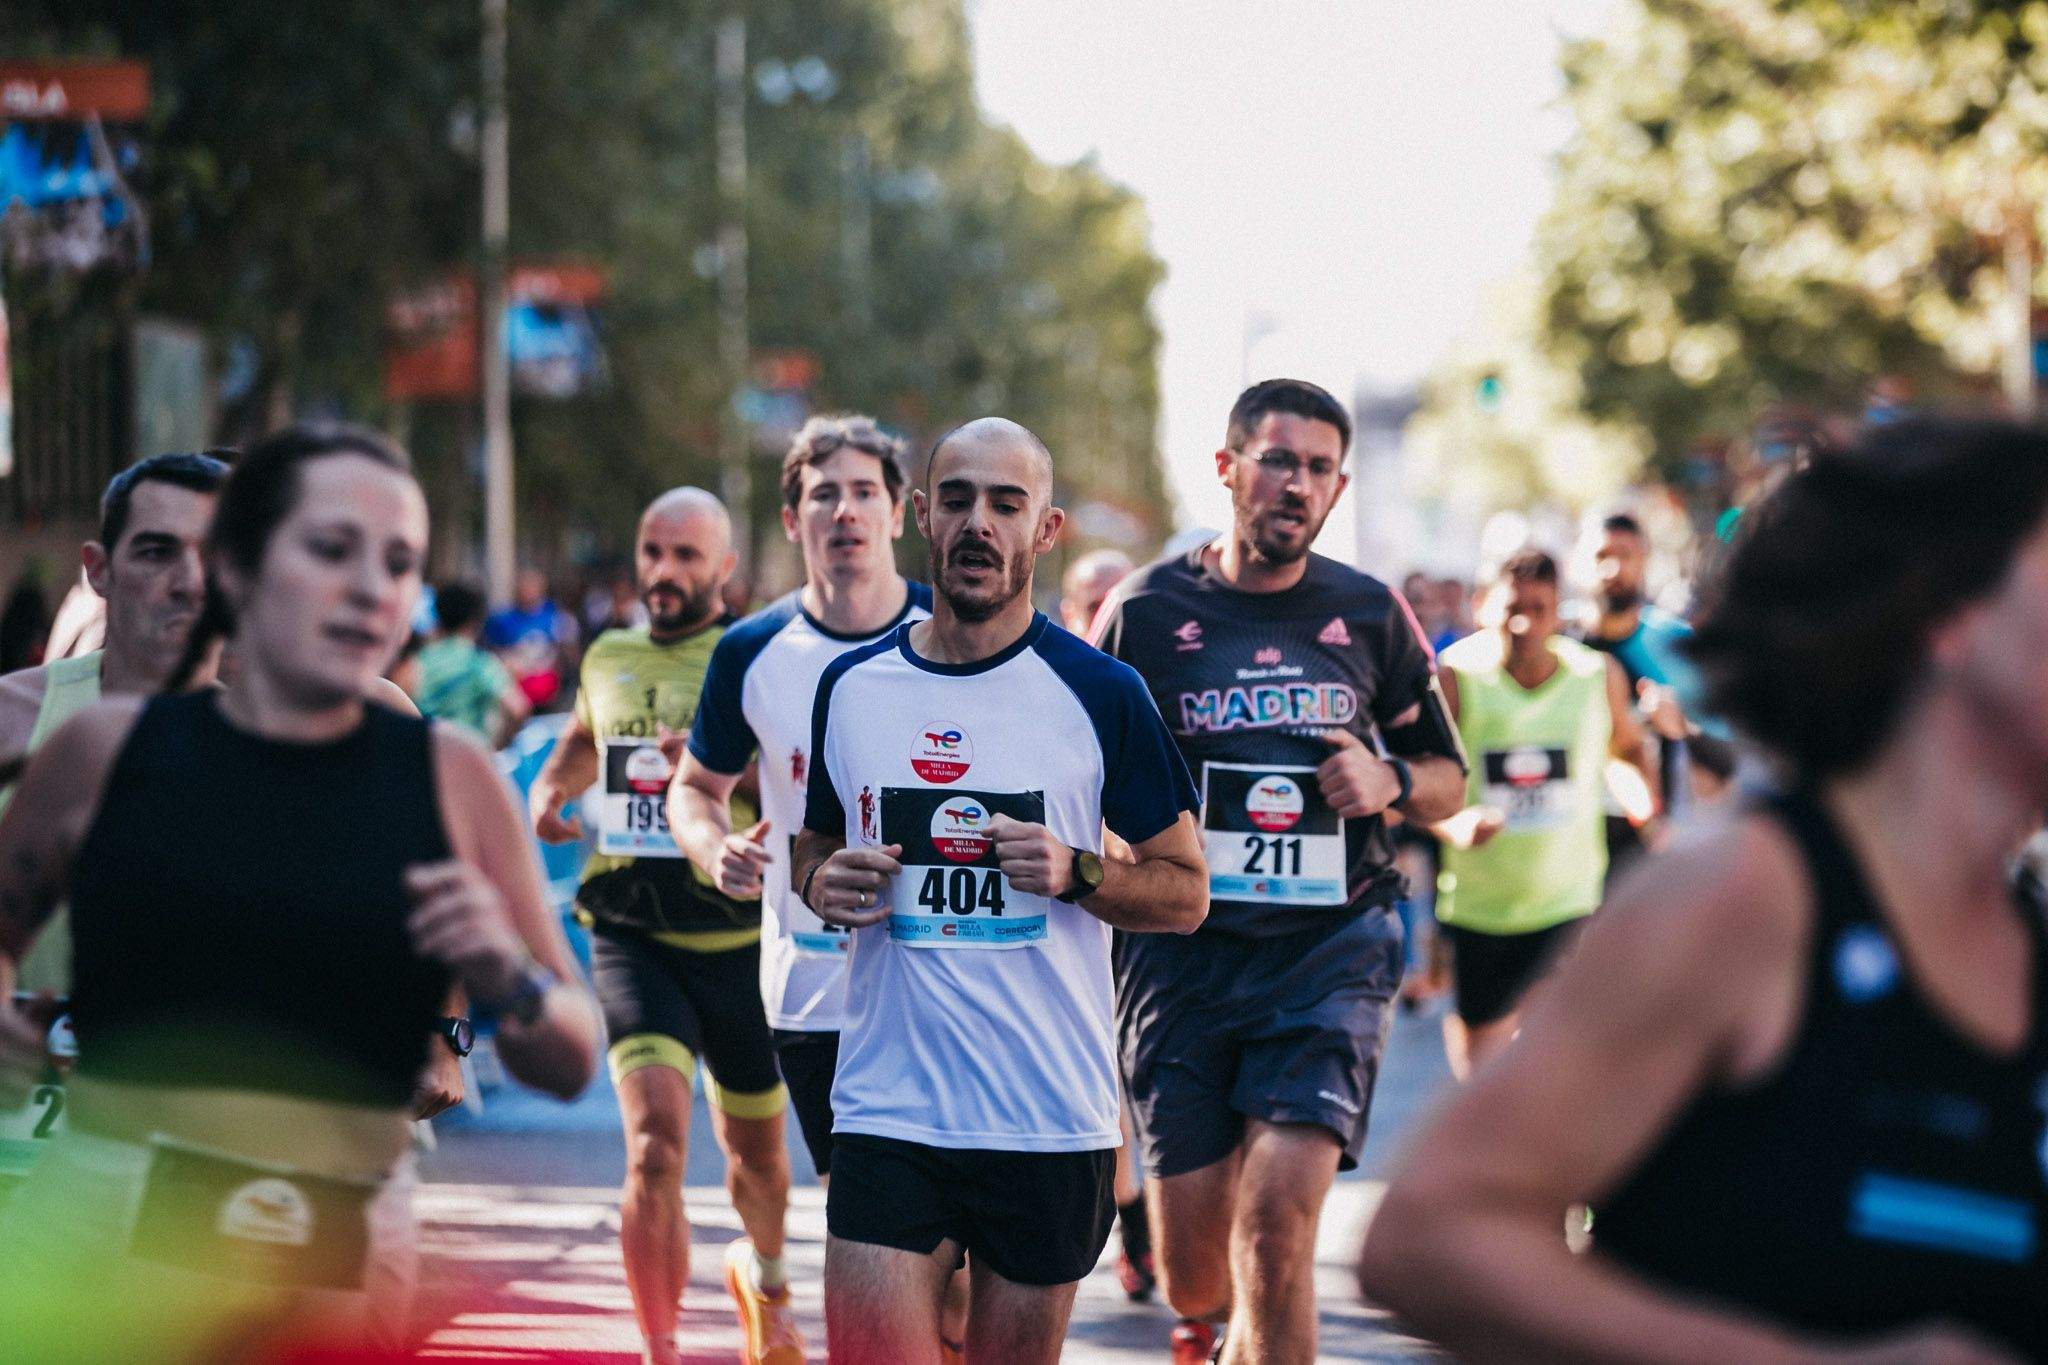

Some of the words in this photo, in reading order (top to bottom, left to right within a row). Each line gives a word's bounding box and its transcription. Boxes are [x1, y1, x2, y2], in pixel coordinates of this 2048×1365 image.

[1180, 683, 1357, 733] MADRID
[923, 750, 960, 758] TotalEnergies
[930, 762, 951, 770] MILLA
[932, 769, 959, 777] MADRID
[1243, 836, 1301, 875] 211
[918, 867, 1005, 916] 404
